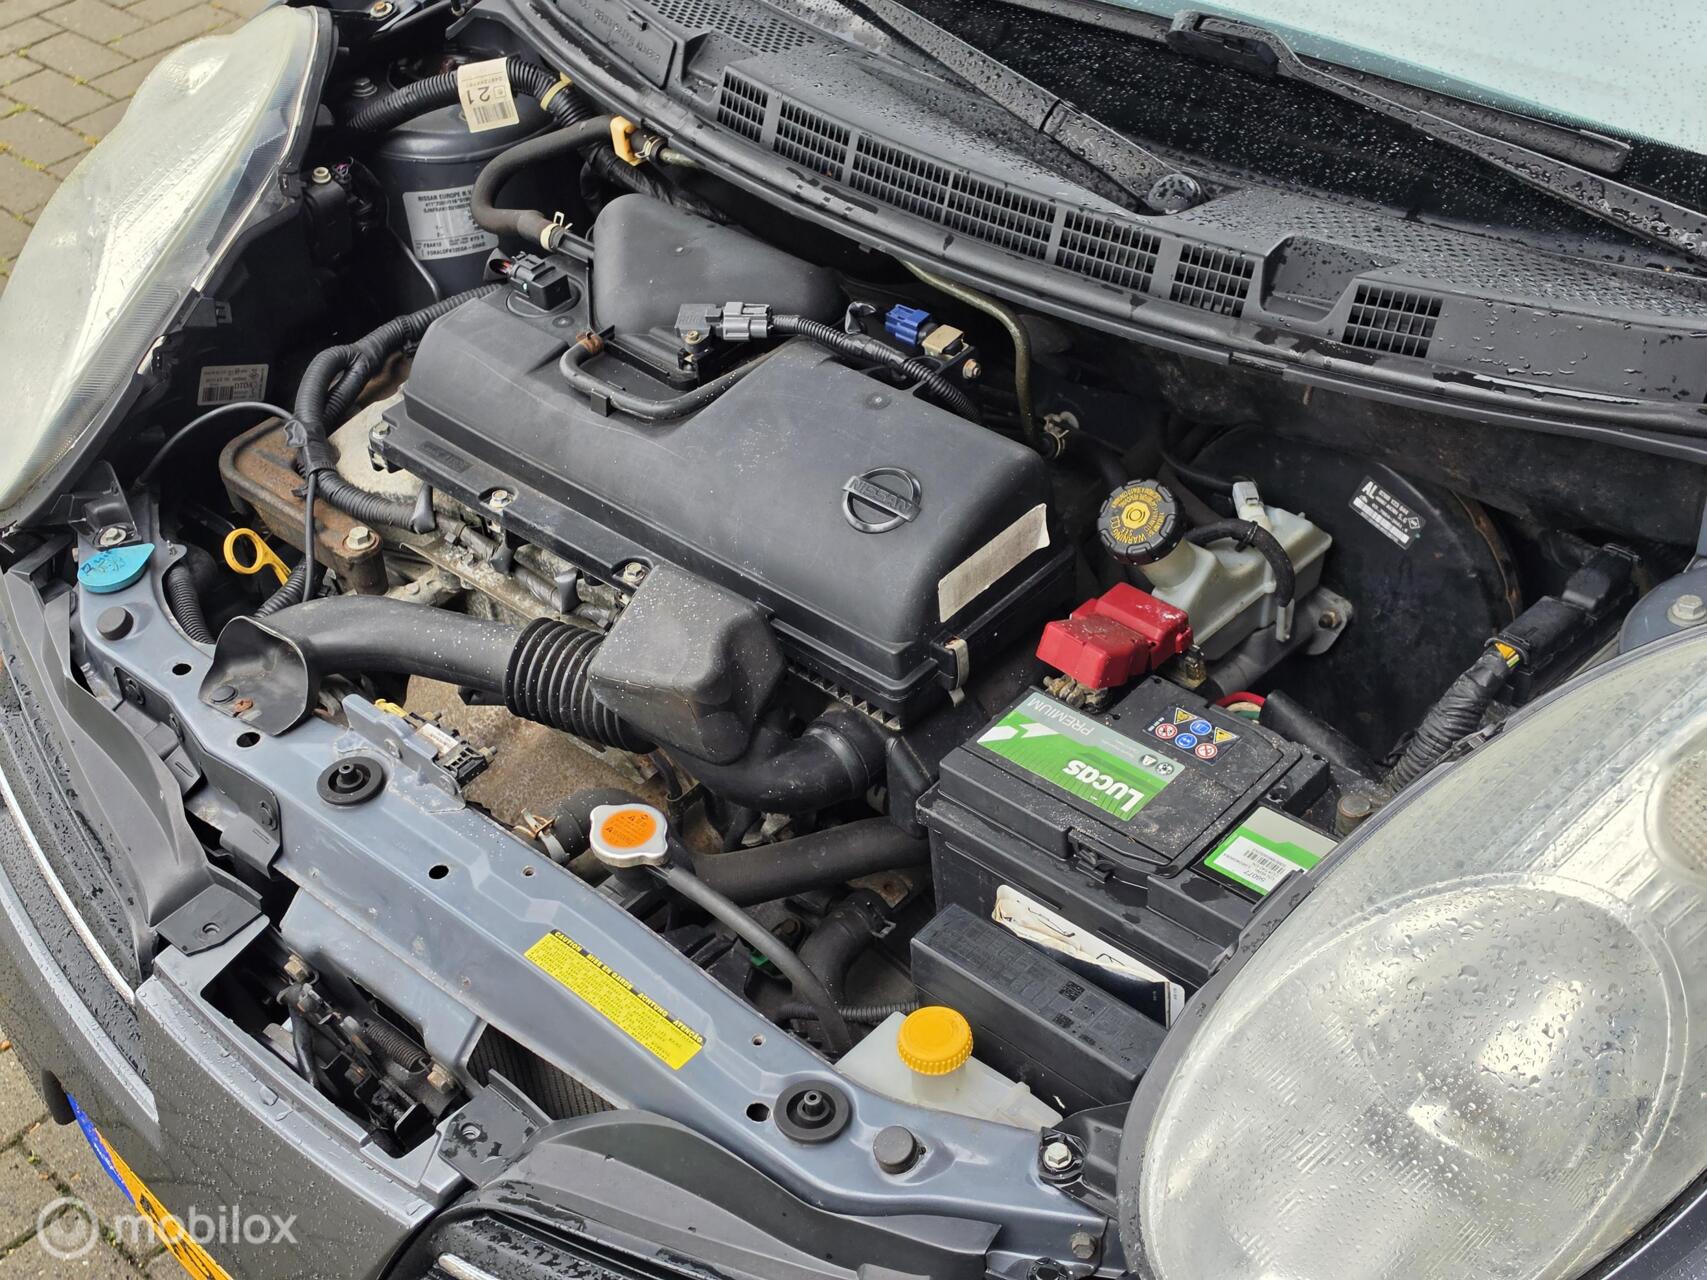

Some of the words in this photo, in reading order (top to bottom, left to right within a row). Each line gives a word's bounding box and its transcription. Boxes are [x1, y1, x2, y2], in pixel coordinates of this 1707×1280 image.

[848, 479, 911, 514] NISSAN
[1113, 528, 1146, 544] WARNING
[1027, 697, 1095, 736] PREMIUM
[555, 931, 583, 952] CAUTION
[638, 992, 669, 1017] ACHTUNG
